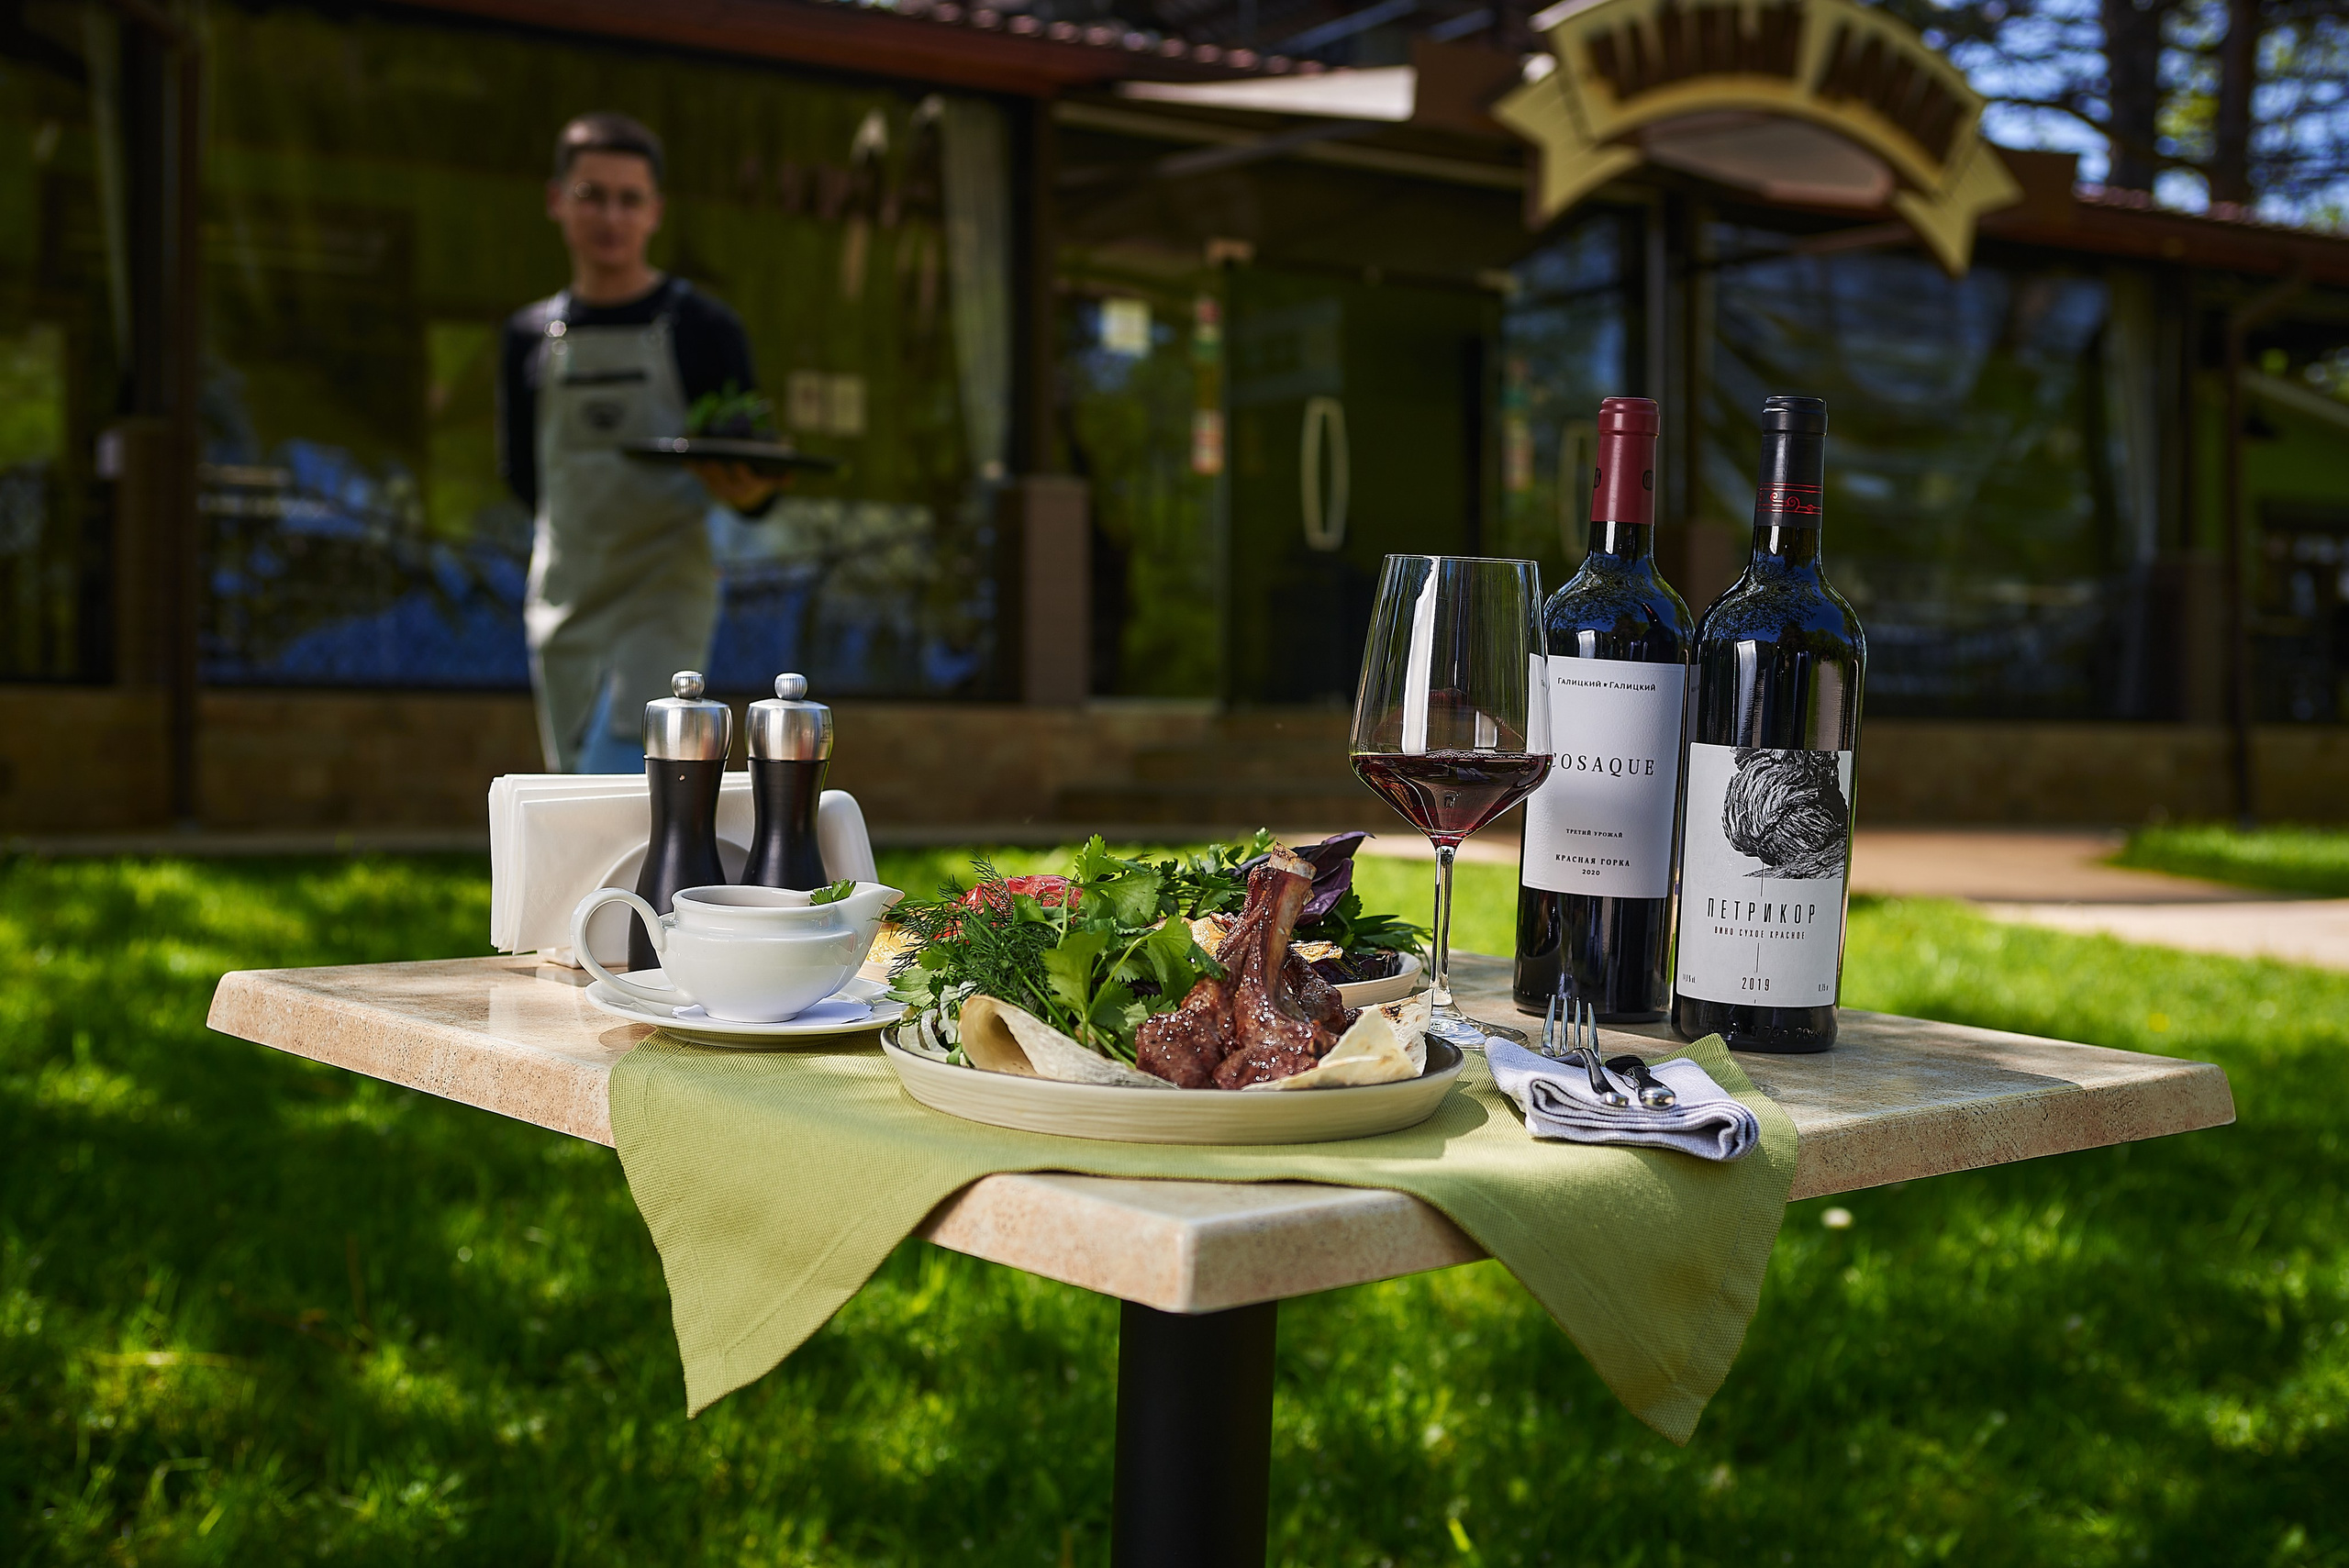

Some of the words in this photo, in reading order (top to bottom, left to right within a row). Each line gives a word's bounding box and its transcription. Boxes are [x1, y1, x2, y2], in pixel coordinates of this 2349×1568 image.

[1565, 828, 1591, 837] ТРЕТИЙ
[1594, 830, 1623, 839] УРОЖАЙ
[1555, 853, 1597, 865] КРАСНАЯ
[1600, 858, 1631, 867] ГОРКА
[1581, 868, 1601, 876] 2020
[1707, 897, 1817, 925] ПЕТРИКОР
[1714, 926, 1734, 936] ВИНО
[1739, 929, 1765, 939] СУХОЕ
[1769, 930, 1806, 940] КРАСНОЕ
[1741, 976, 1771, 992] 2019
